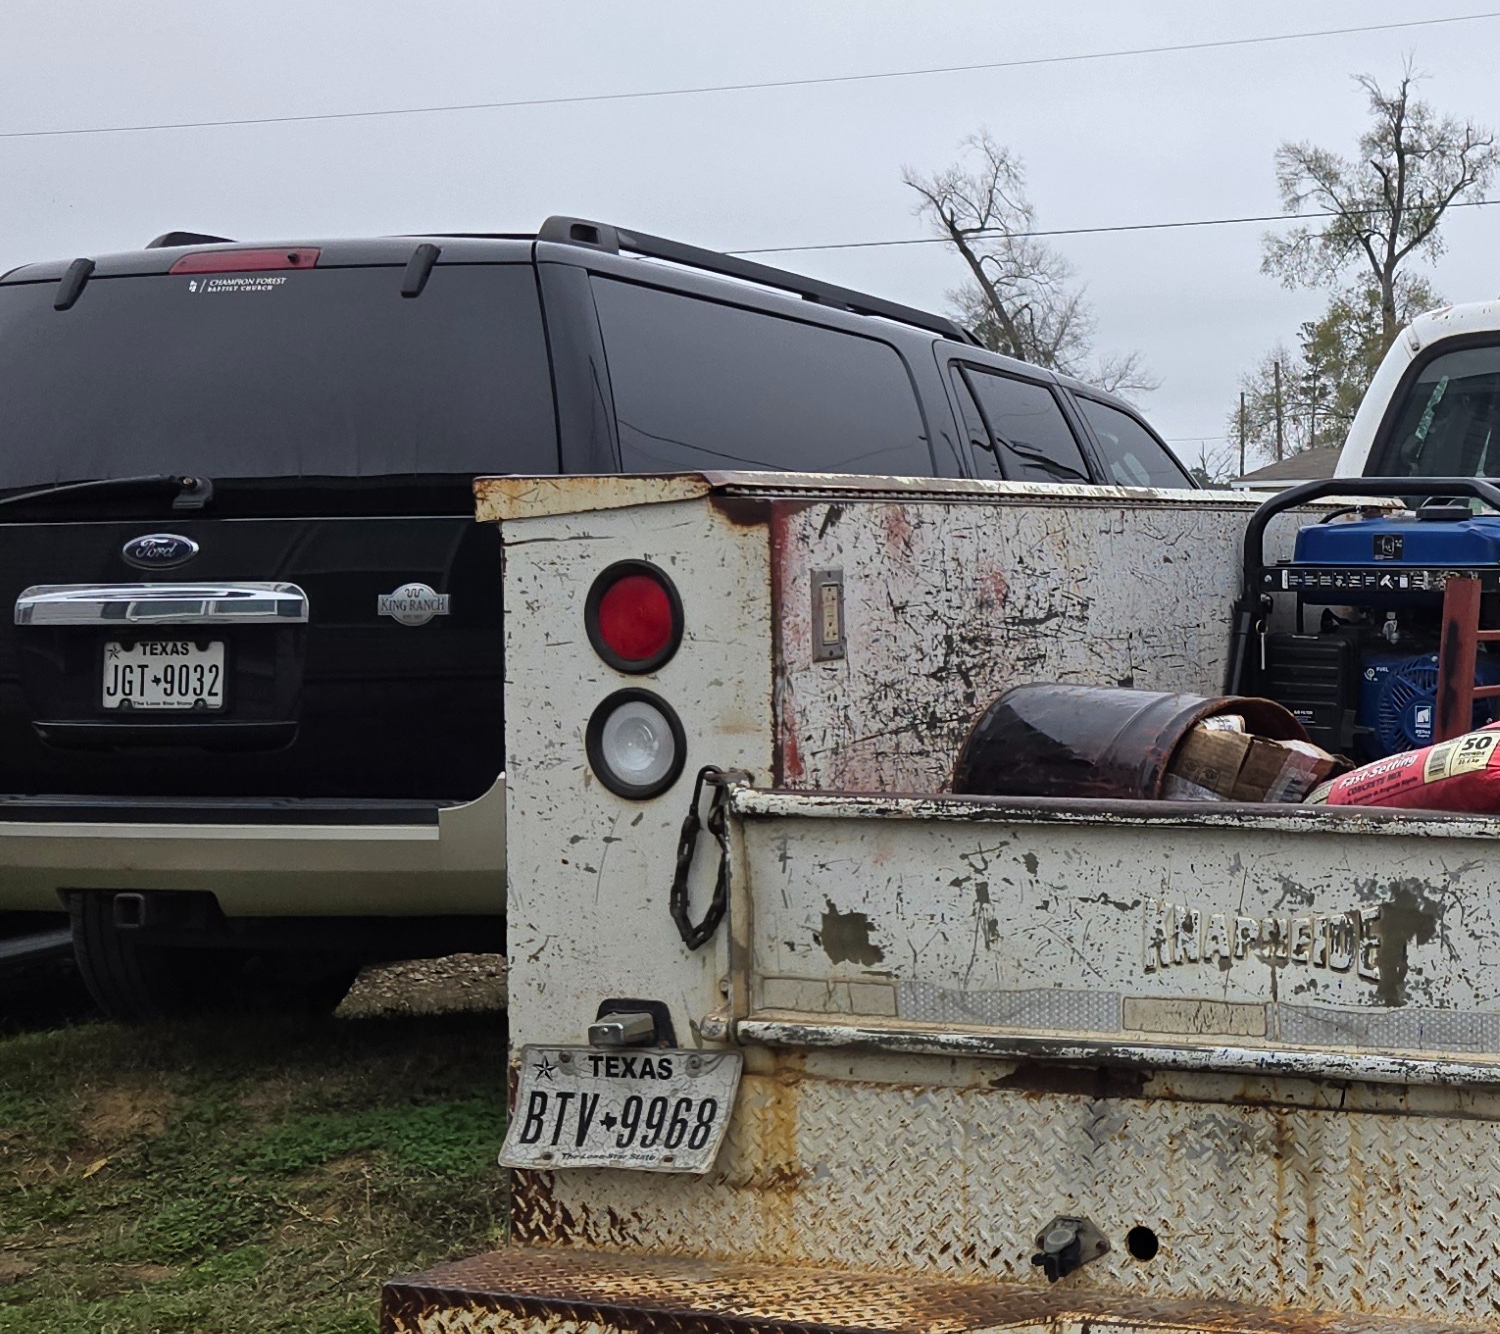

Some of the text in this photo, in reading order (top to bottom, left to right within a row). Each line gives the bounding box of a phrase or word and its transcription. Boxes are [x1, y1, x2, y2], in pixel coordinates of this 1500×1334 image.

[207, 285, 239, 293] BAPTIST
[209, 277, 287, 286] CHAMPION FOREST
[135, 538, 177, 558] Ford
[381, 598, 445, 611] KING RANCH
[140, 642, 190, 656] TEXAS
[1461, 736, 1493, 751] 50
[1338, 754, 1419, 791] Fast-Setting
[1347, 776, 1387, 797] CONCRETE
[1145, 896, 1382, 982] KNAPHEIDE
[588, 1055, 673, 1080] TEXAS
